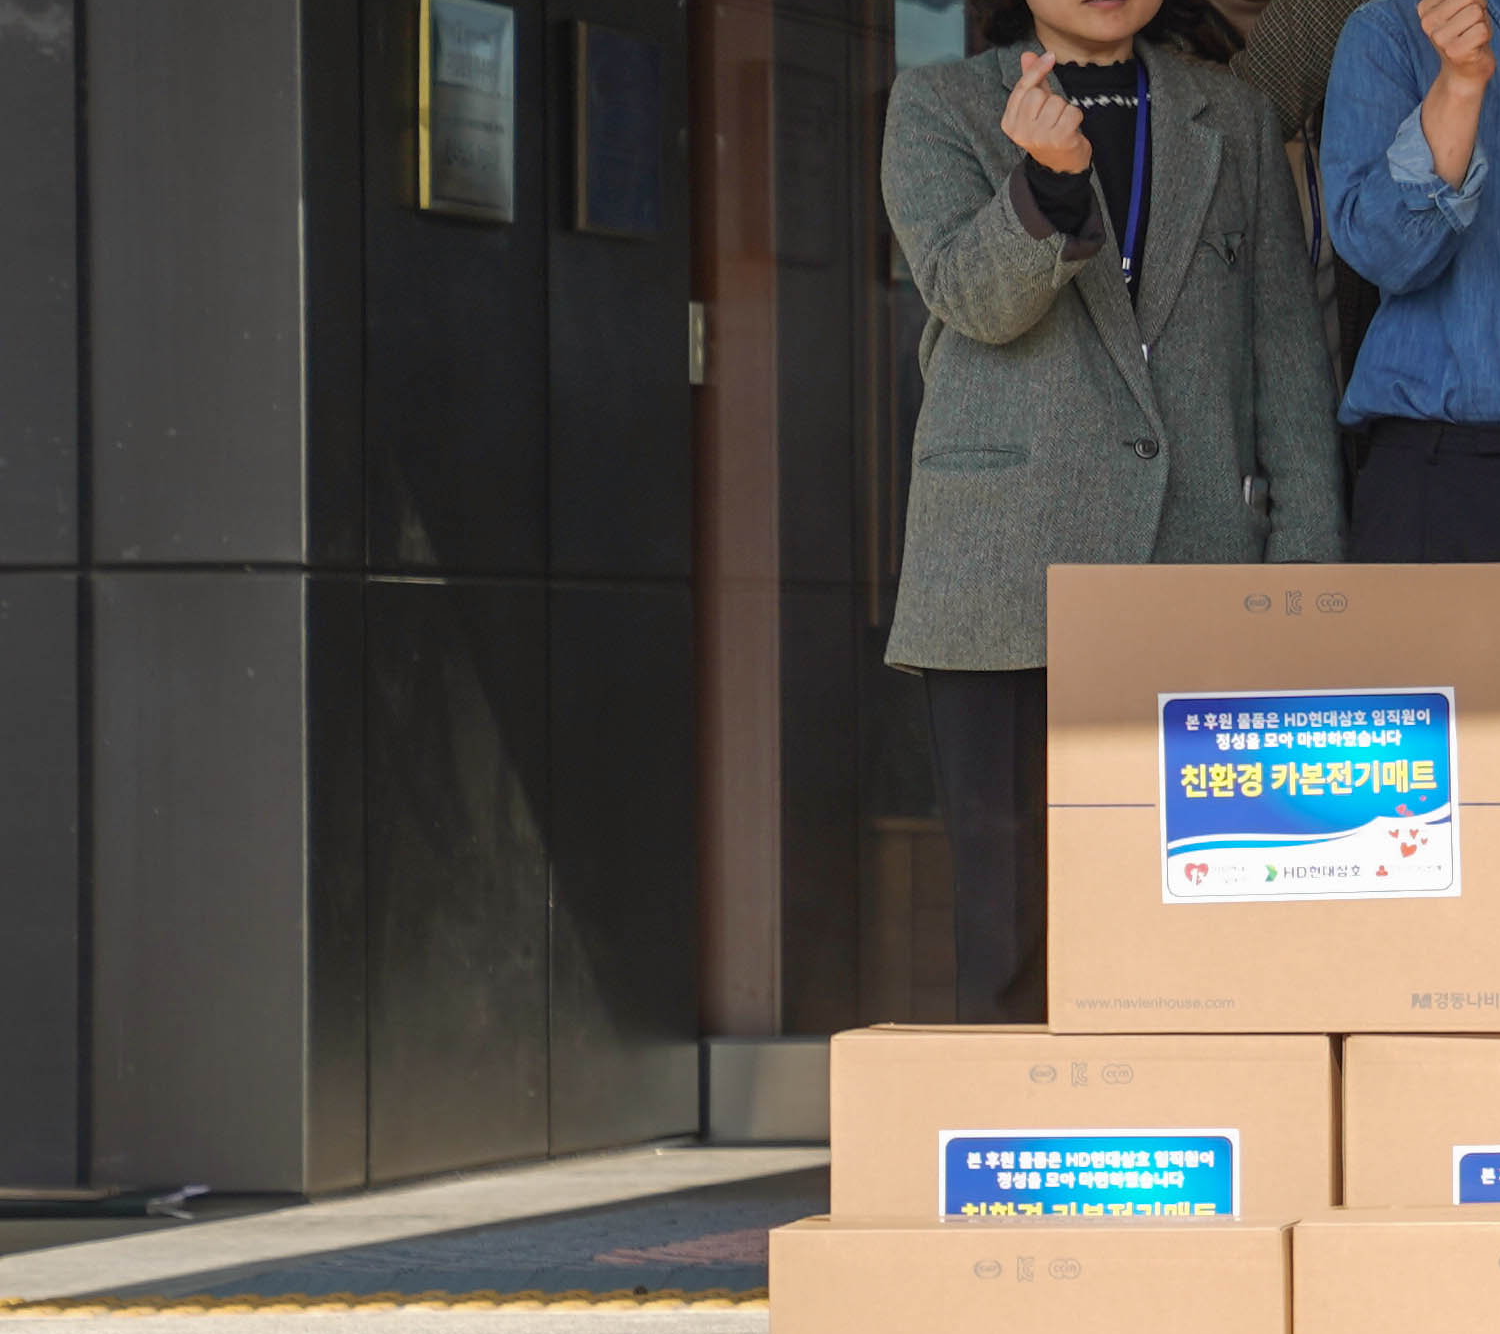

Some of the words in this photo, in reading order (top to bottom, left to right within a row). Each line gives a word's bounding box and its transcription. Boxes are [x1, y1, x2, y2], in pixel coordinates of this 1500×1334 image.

[1185, 713, 1200, 730] 본
[1203, 712, 1233, 730] 후원
[1237, 711, 1280, 729] 물품은
[1284, 709, 1367, 728] HD현대삼호
[1371, 708, 1431, 726] 임직원이
[1216, 732, 1260, 749] 정성을
[1264, 731, 1294, 748] 모아
[1297, 729, 1402, 747] 마련하였습니다
[1181, 762, 1263, 797] 친환경
[1270, 758, 1437, 795] 카본전기매트
[1075, 995, 1235, 1010] www.navienhouse.com
